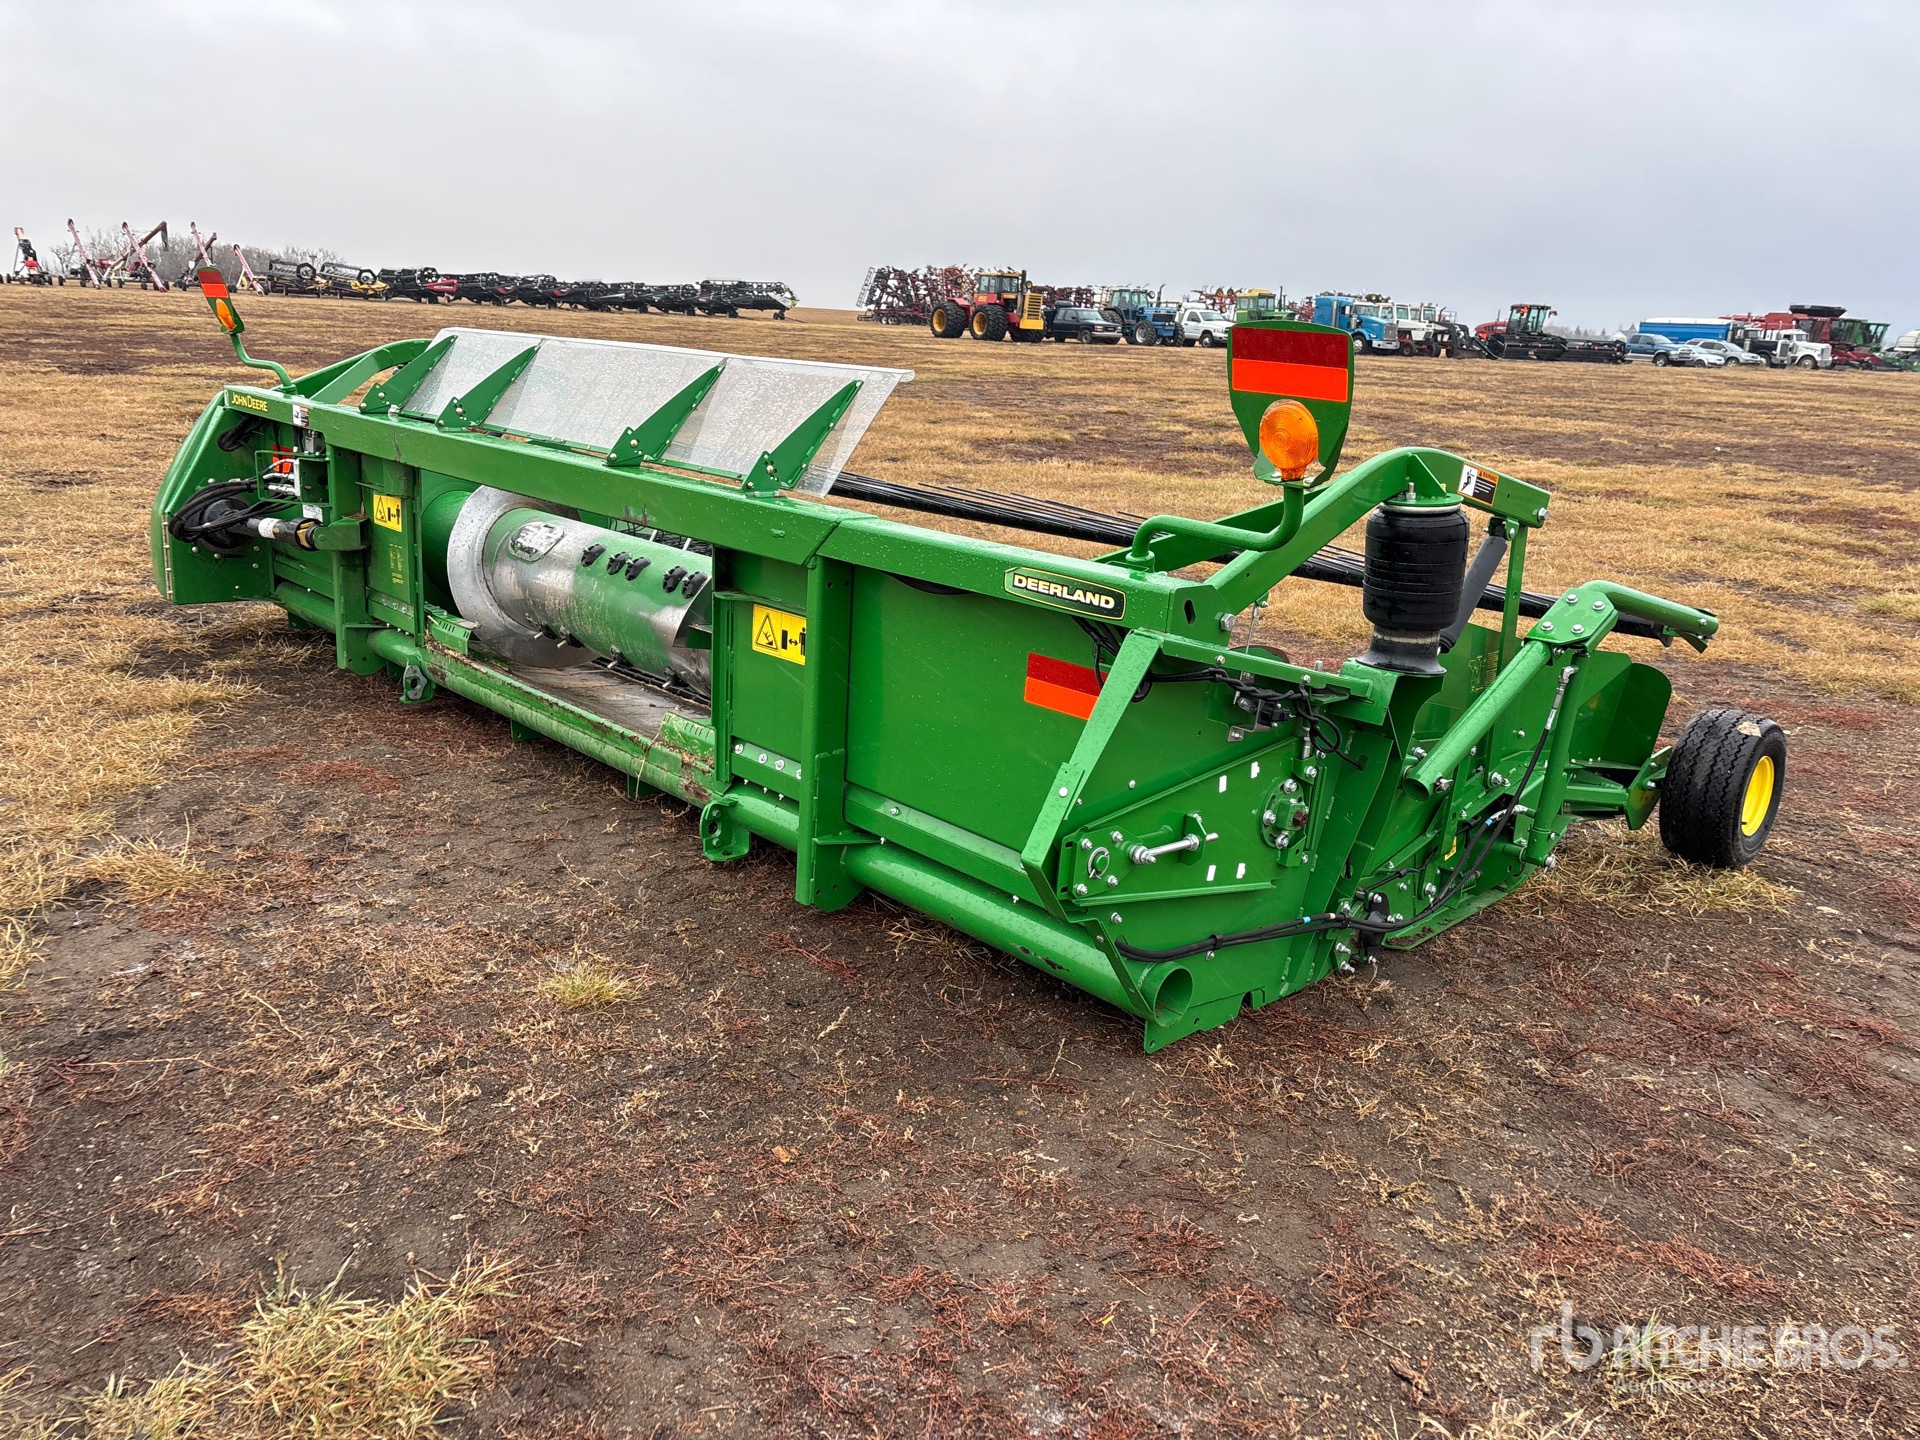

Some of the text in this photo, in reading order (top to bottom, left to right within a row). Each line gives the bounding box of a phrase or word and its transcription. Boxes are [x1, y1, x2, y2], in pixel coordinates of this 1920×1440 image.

[231, 391, 269, 412] JOHN DEERE
[1013, 573, 1116, 610] DEERLAND
